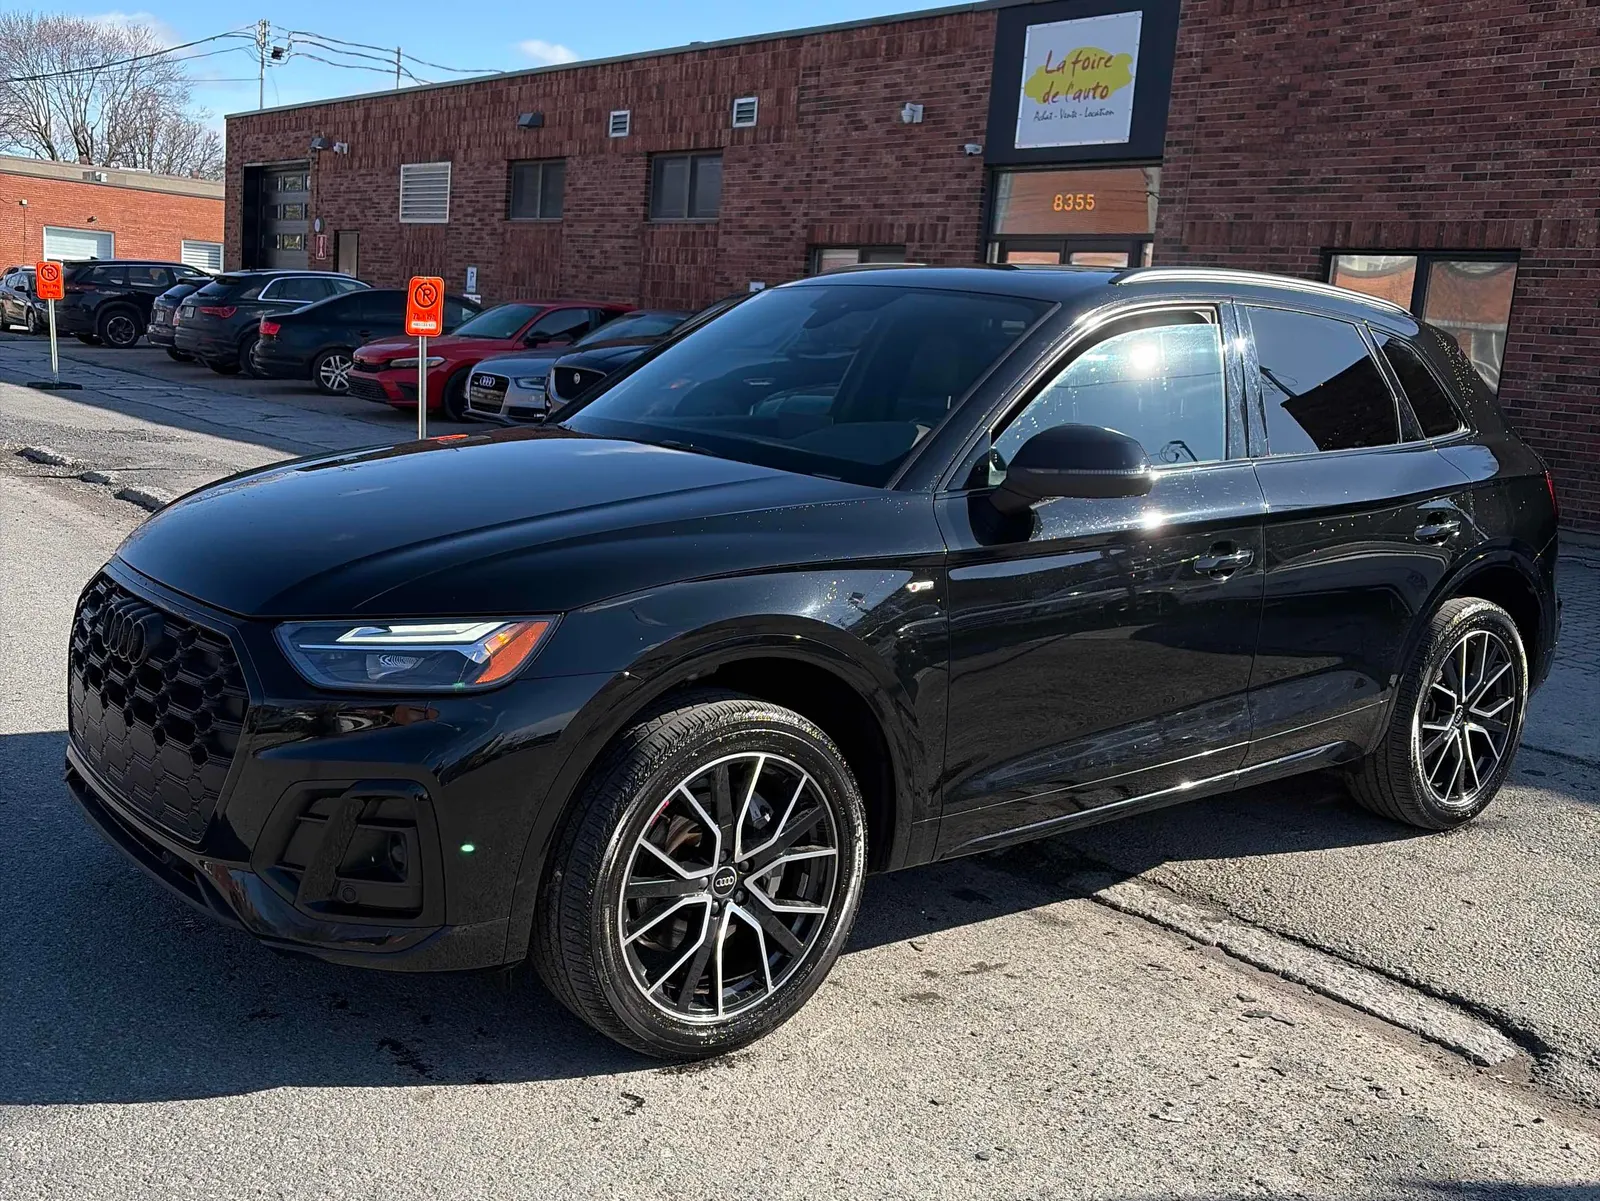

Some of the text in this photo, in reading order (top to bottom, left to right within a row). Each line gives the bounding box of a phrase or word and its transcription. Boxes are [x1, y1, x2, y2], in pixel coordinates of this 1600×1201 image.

[1045, 50, 1114, 78] La foire
[1042, 80, 1110, 105] de l'auto
[1033, 110, 1054, 122] Achat
[1059, 108, 1078, 119] Vente
[1084, 106, 1115, 118] Location
[1053, 193, 1096, 211] 8355
